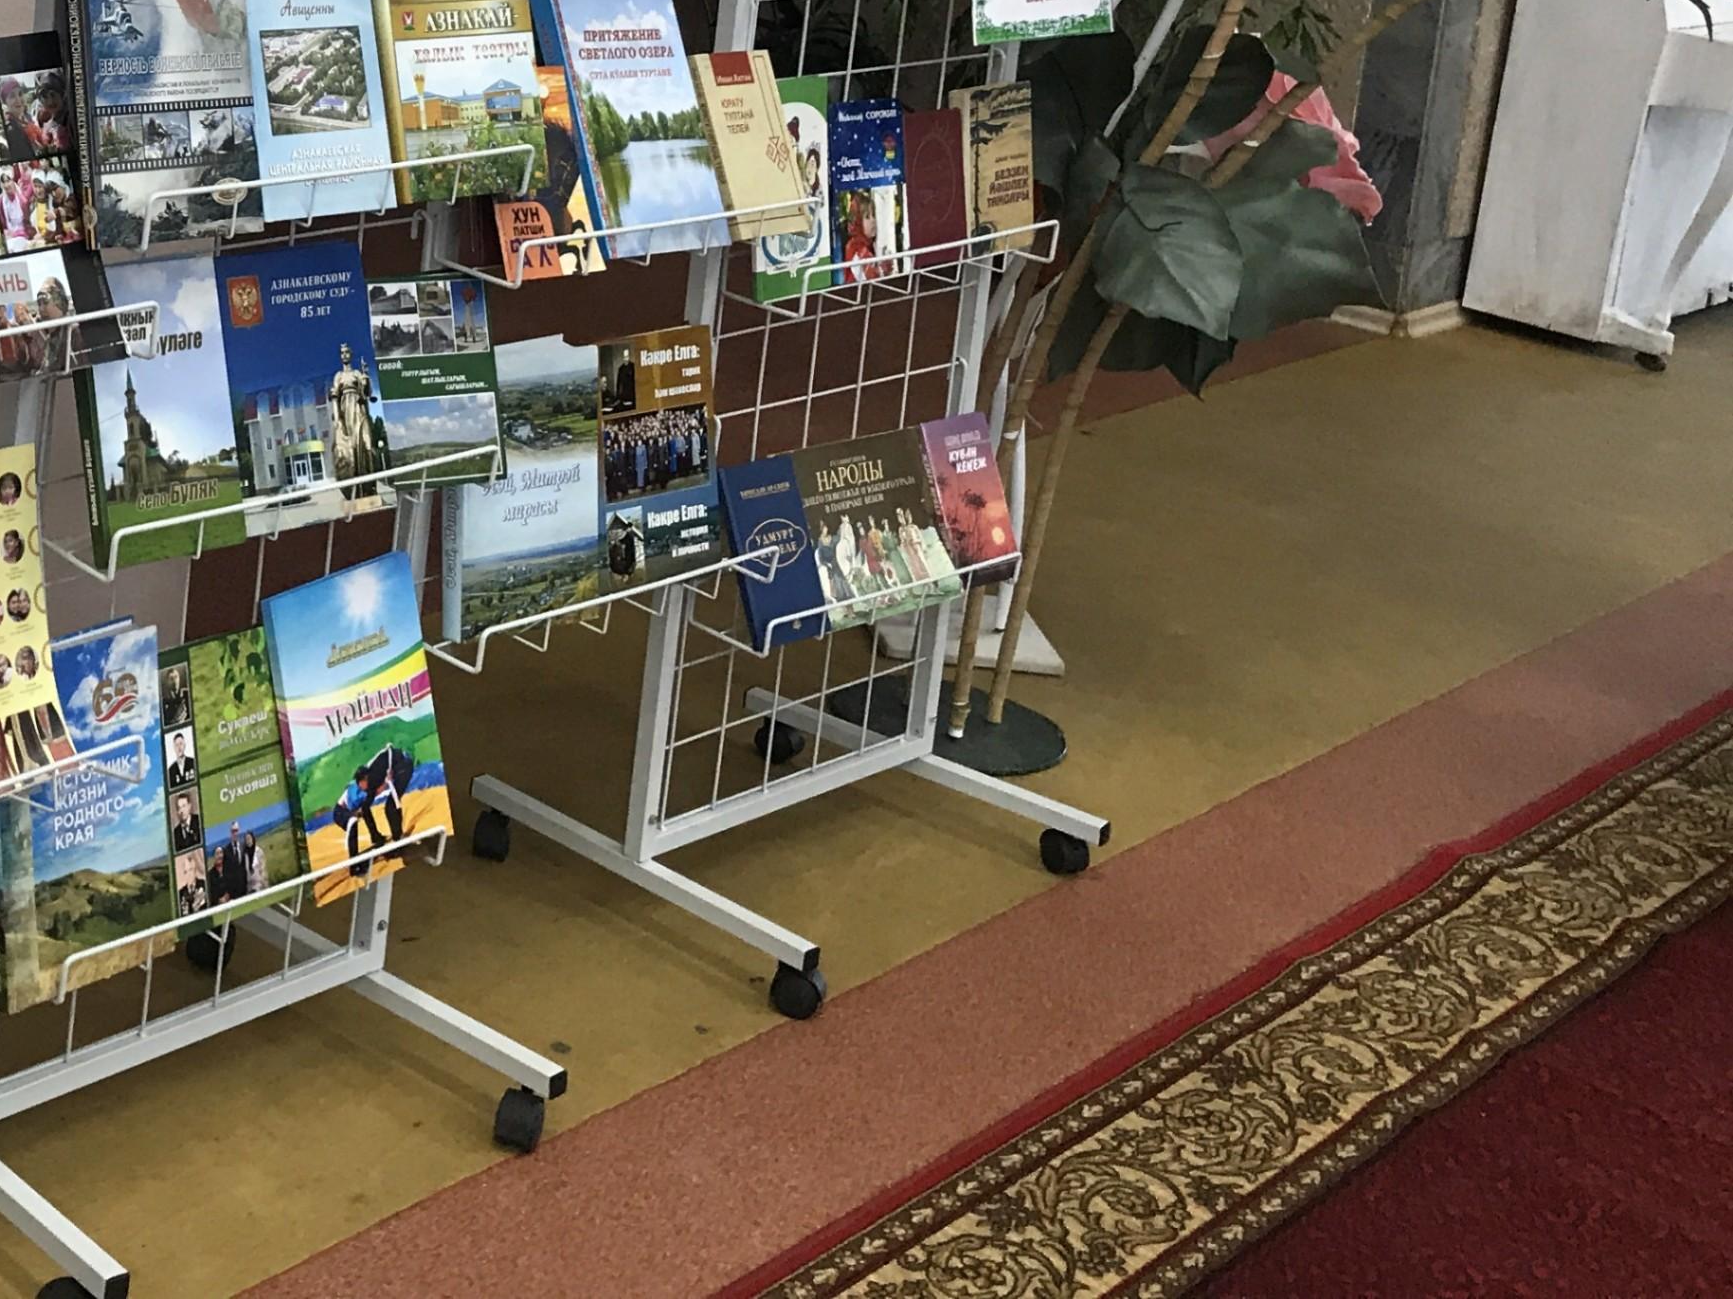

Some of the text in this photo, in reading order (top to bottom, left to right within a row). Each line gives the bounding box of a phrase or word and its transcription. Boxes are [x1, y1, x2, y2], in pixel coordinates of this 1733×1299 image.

[279, 0, 336, 21] Авиценны
[583, 29, 662, 43] ПРИТЯЖЕНИЕ
[578, 47, 675, 61] СВЕТЛОГО ОЗЕРА
[98, 56, 149, 77] ВЕРНОСТЬ
[511, 206, 541, 224] ХУН
[270, 271, 352, 291] АЗНАКАЕВСКОМУ
[271, 285, 350, 305] ГОРОДСКОМУ СУДУ
[300, 305, 314, 318] 85
[156, 330, 203, 356] үләге
[815, 459, 885, 493] НАРОДЫ
[170, 479, 219, 507] Буляк
[681, 504, 708, 521] Елга:
[755, 527, 795, 546] УДМУРТ
[219, 774, 279, 803] Сухояша
[54, 795, 126, 832] РОДНОГО
[55, 824, 95, 851] КРАЯ
